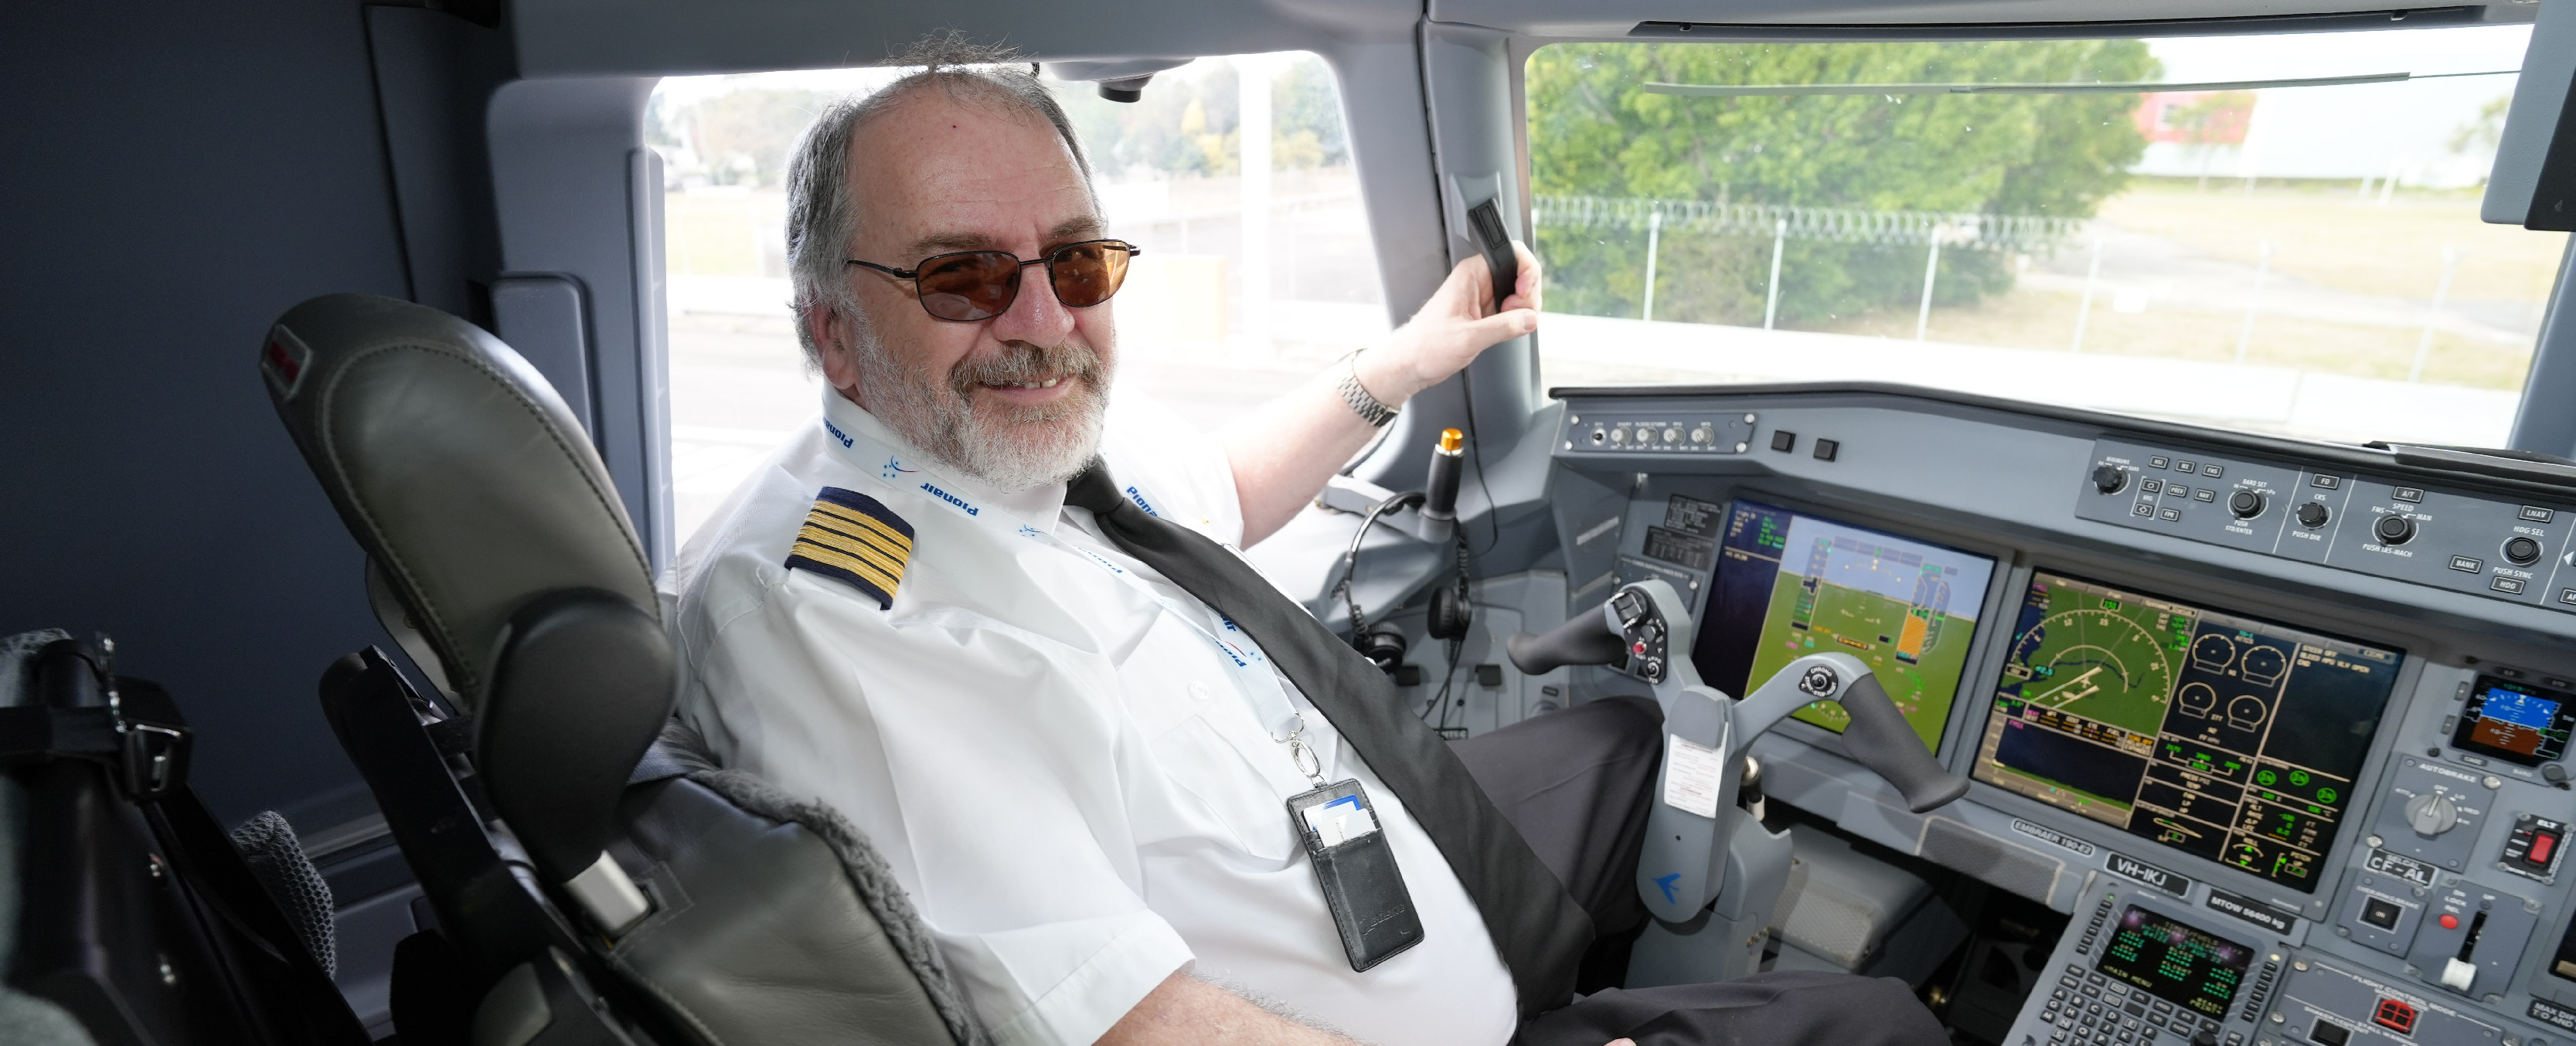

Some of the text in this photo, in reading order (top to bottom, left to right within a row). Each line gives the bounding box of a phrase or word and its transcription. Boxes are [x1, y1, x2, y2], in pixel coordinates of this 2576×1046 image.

[2242, 478, 2256, 487] BARO
[920, 482, 979, 516] Pionair
[1126, 486, 1158, 517] Piona
[2371, 505, 2386, 514] FMS
[2392, 503, 2414, 512] SPEED
[2526, 509, 2547, 518] LNAV
[2416, 513, 2433, 521] MAN
[2234, 520, 2249, 528] PUSH
[2292, 531, 2322, 542] PUSH DIR
[2513, 525, 2544, 537] HDG SEL
[2362, 543, 2413, 558] PUSH IAS-MACH
[2455, 559, 2476, 569] BANK
[2493, 567, 2533, 579] PUSH SYNC
[2499, 581, 2516, 589] HDG
[1810, 666, 1832, 678] CHRONO
[2351, 664, 2370, 674] OPEN
[2419, 763, 2477, 783] AUTOBRAKE
[2014, 820, 2060, 843] EMBRAER
[2117, 858, 2167, 887] VH-IKJ
[2211, 896, 2243, 912] MTOW
[2444, 895, 2467, 908] LOCK
[2353, 975, 2384, 990] FLIGHT
[2384, 985, 2428, 1007] CONTROL
[2429, 1002, 2456, 1017] MODE
[2534, 1003, 2557, 1015] MAX
[2550, 1015, 2574, 1029] AND
